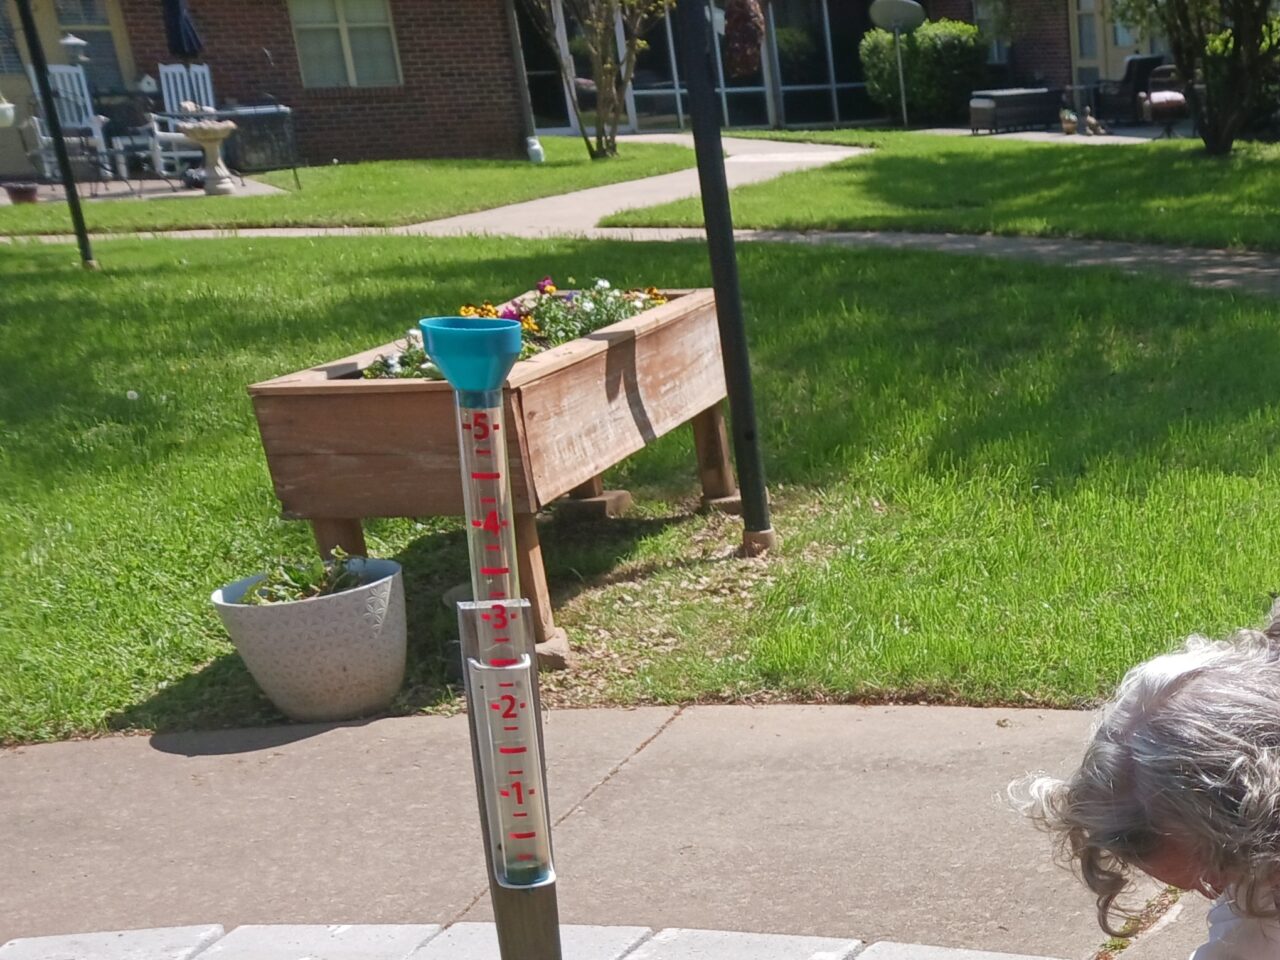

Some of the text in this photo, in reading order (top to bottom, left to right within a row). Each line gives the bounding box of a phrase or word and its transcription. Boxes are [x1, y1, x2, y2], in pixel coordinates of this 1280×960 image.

[472, 412, 490, 440] 5
[482, 508, 501, 537] 4
[490, 604, 508, 630] 3
[499, 694, 518, 719] 2
[510, 781, 524, 805] 1
